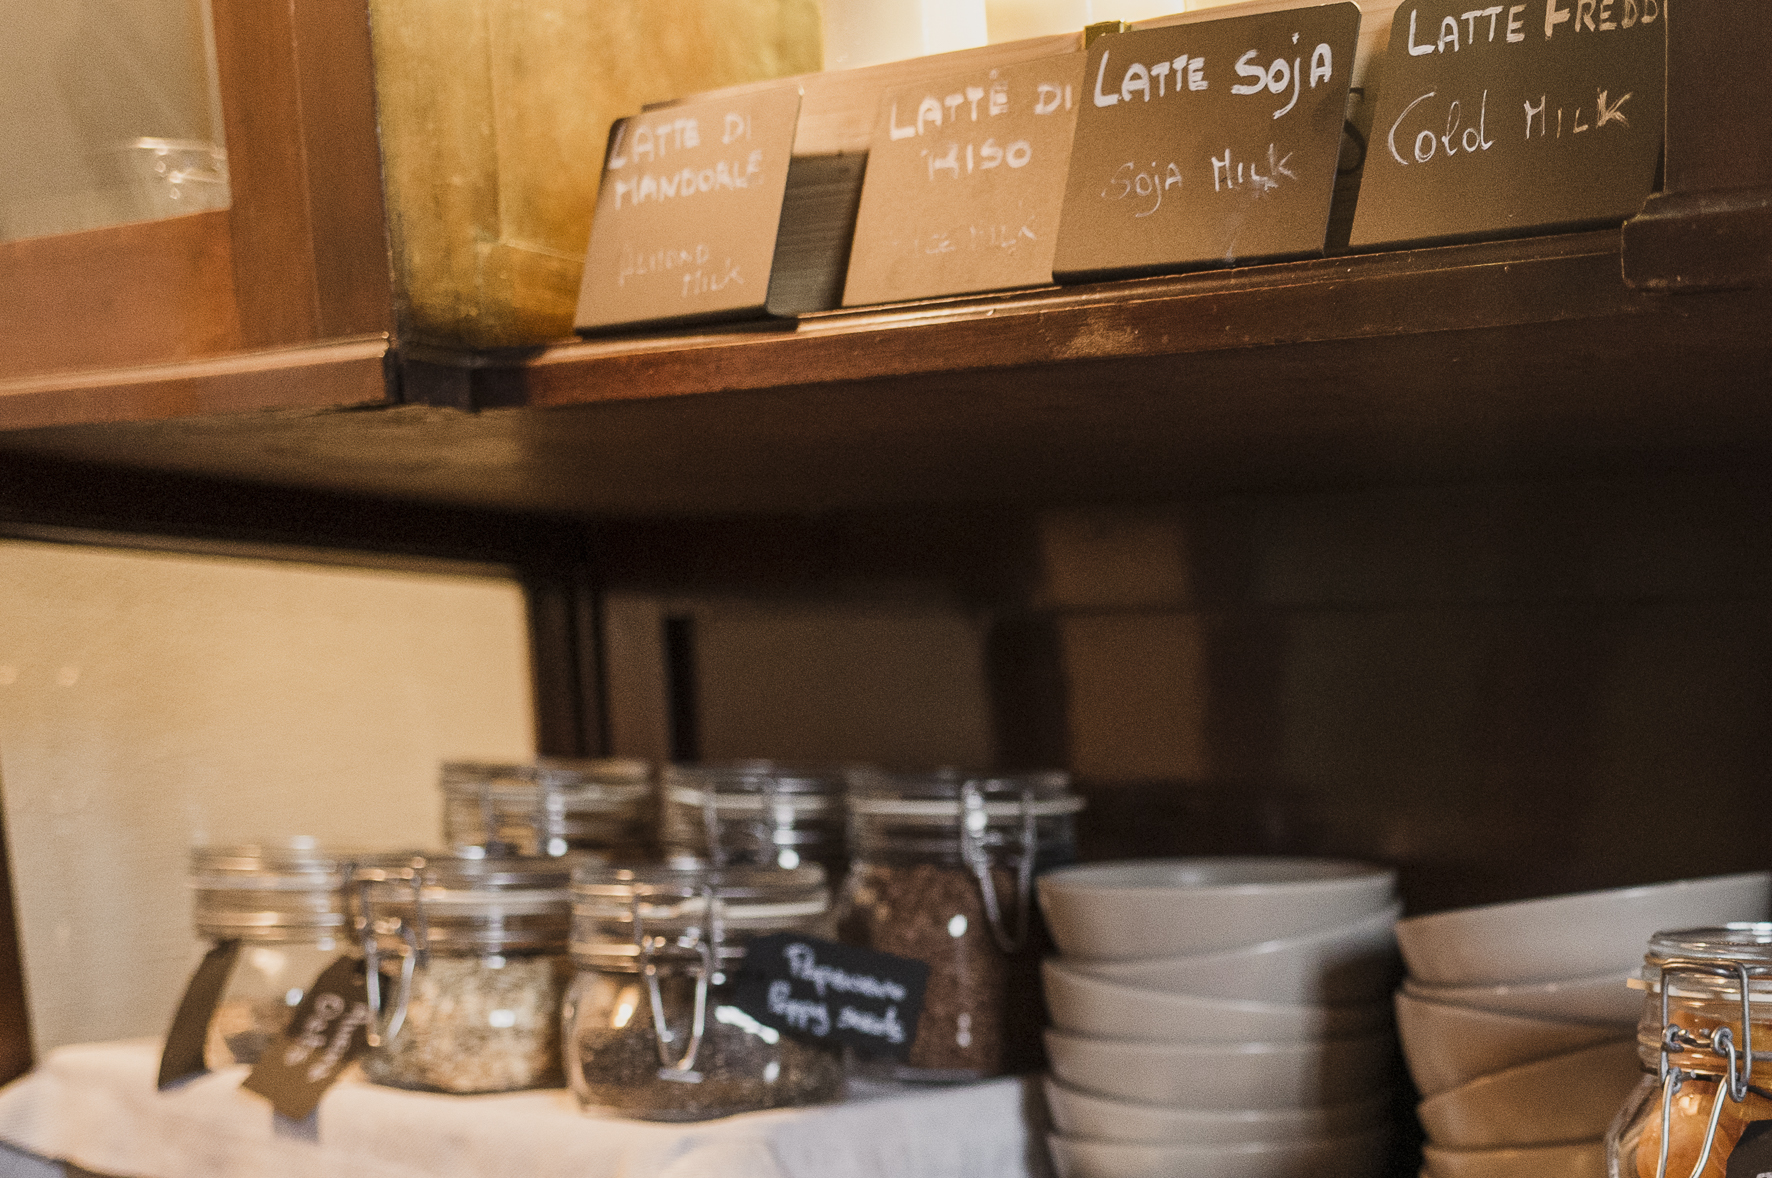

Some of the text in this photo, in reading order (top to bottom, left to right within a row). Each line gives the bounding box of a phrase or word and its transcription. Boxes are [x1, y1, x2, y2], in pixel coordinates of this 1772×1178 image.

[1408, 3, 1526, 56] LATTE
[890, 72, 1073, 141] LATTE DI
[1094, 50, 1208, 107] LATTE
[608, 112, 752, 170] LATTE DI
[1388, 90, 1495, 165] Cold
[614, 149, 763, 211] MANDORLE
